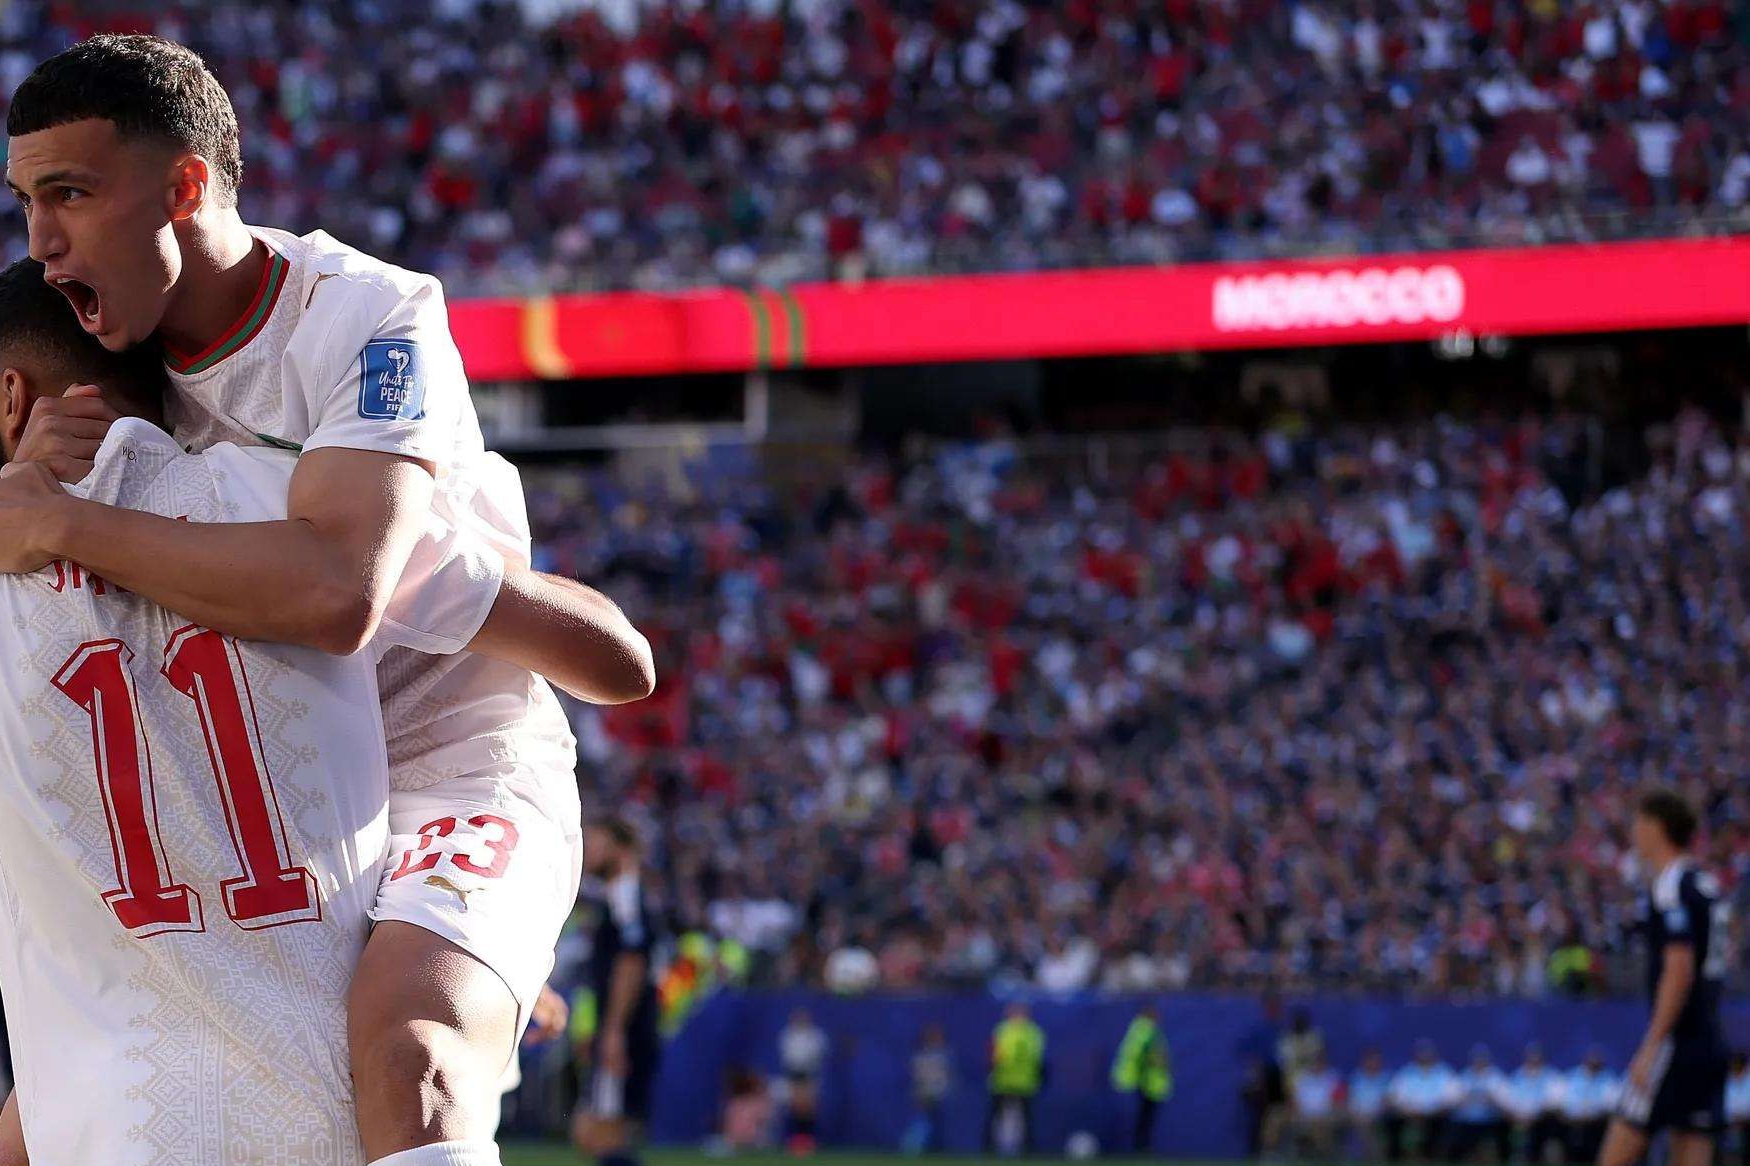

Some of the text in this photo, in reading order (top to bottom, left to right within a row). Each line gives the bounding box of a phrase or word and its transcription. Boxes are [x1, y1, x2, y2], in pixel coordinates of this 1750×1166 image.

[1212, 265, 1464, 332] MOROCCO
[380, 386, 411, 405] PEACE
[386, 404, 404, 413] FIFA
[50, 623, 322, 939] 11
[389, 814, 520, 882] 23
